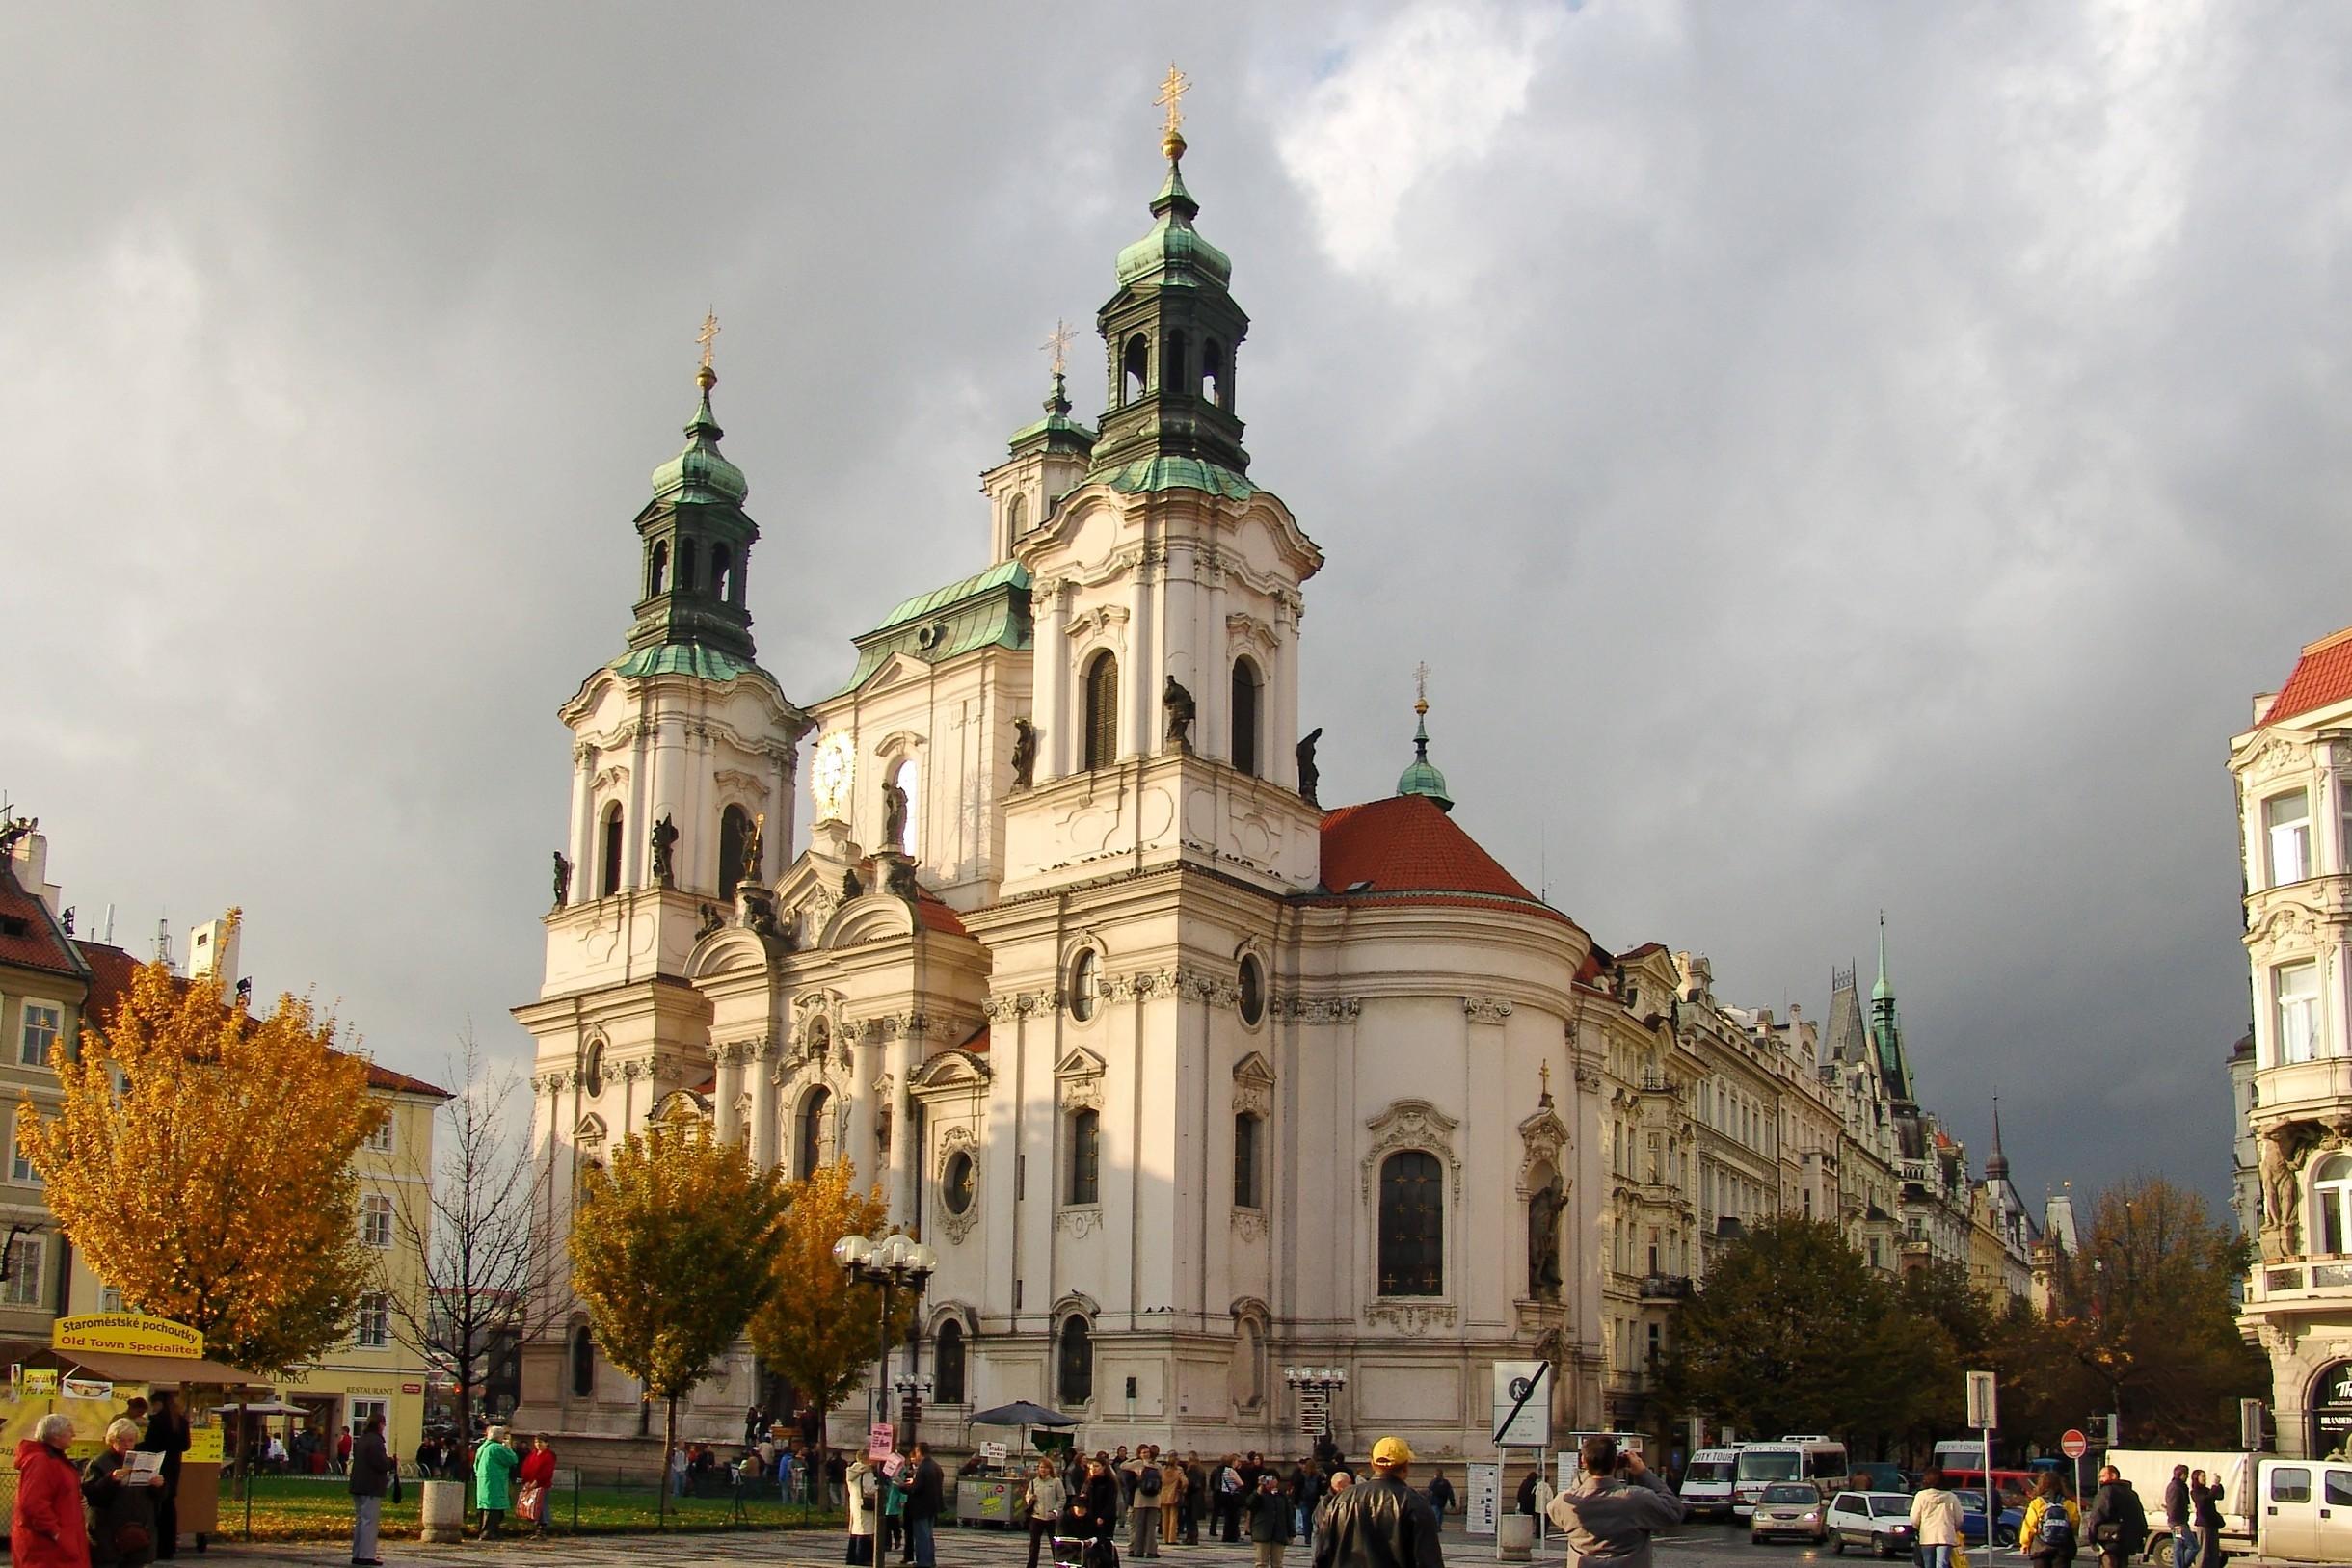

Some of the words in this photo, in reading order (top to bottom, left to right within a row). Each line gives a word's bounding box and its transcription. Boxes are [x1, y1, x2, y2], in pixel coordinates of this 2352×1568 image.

[62, 1316, 140, 1333] Staroměstské
[142, 1319, 198, 1344] pochoutky
[61, 1336, 86, 1346] Old
[90, 1338, 125, 1349] Town
[346, 1386, 394, 1395] RESTAURANT
[1693, 1452, 1710, 1462] CITY
[1712, 1452, 1734, 1462] TOUR
